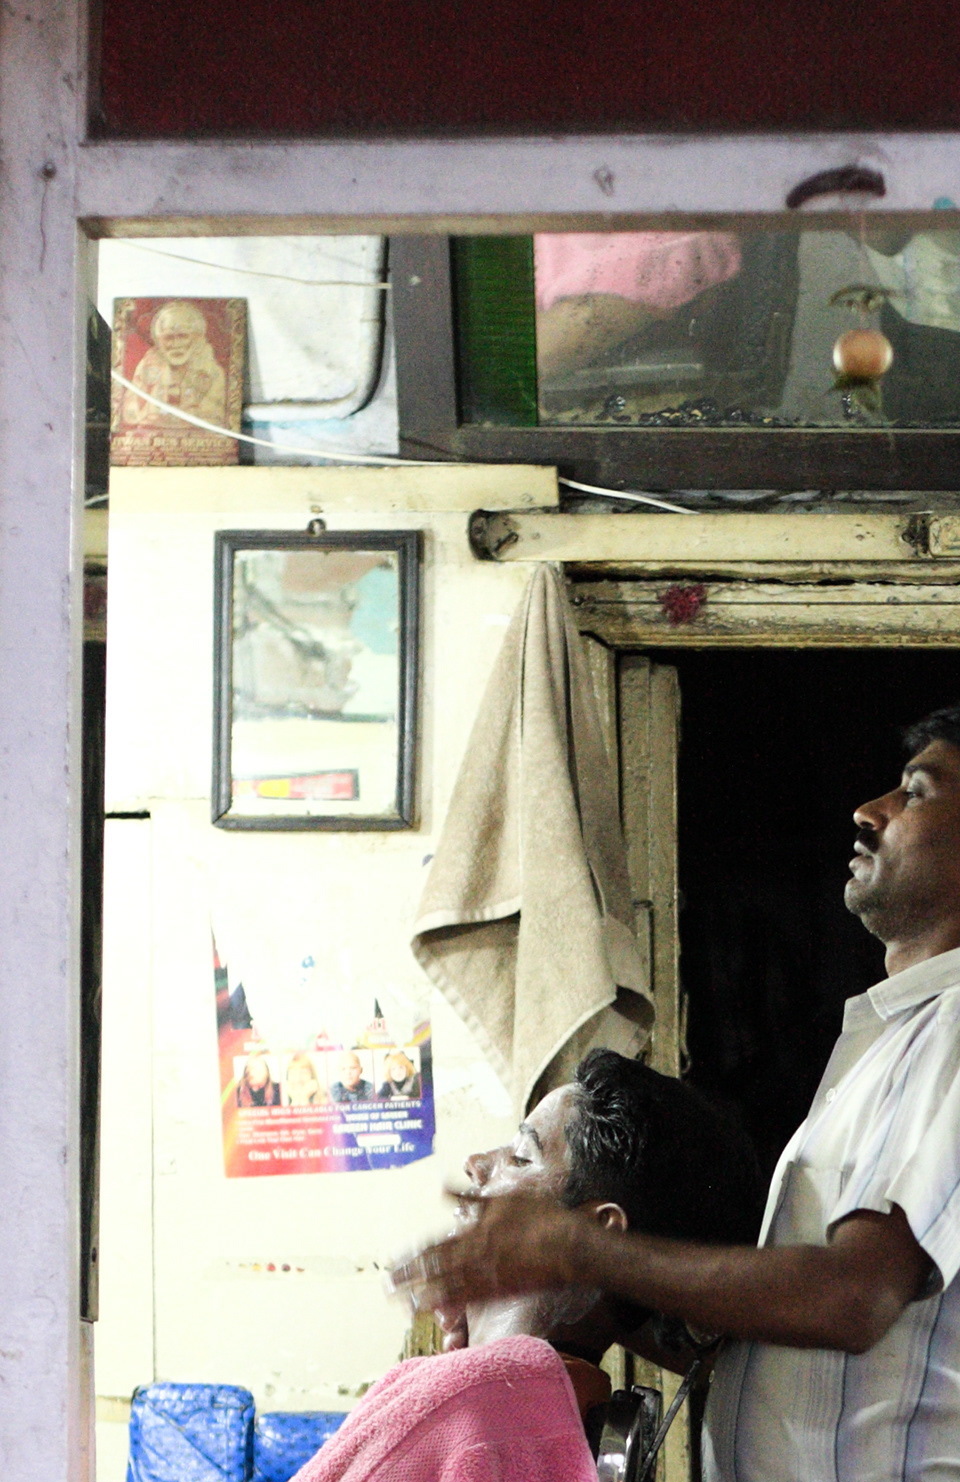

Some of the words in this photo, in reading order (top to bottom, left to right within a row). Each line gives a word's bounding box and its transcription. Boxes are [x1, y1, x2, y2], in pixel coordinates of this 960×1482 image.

[336, 1104, 350, 1112] FOR
[352, 1102, 383, 1110] CANCER
[385, 1100, 421, 1109] PATIENTS
[394, 1119, 423, 1130] CLINIC
[248, 1150, 271, 1161] One
[273, 1148, 297, 1159] Visit
[299, 1147, 321, 1158] Can
[324, 1146, 363, 1157] Change
[394, 1142, 414, 1153] Life
